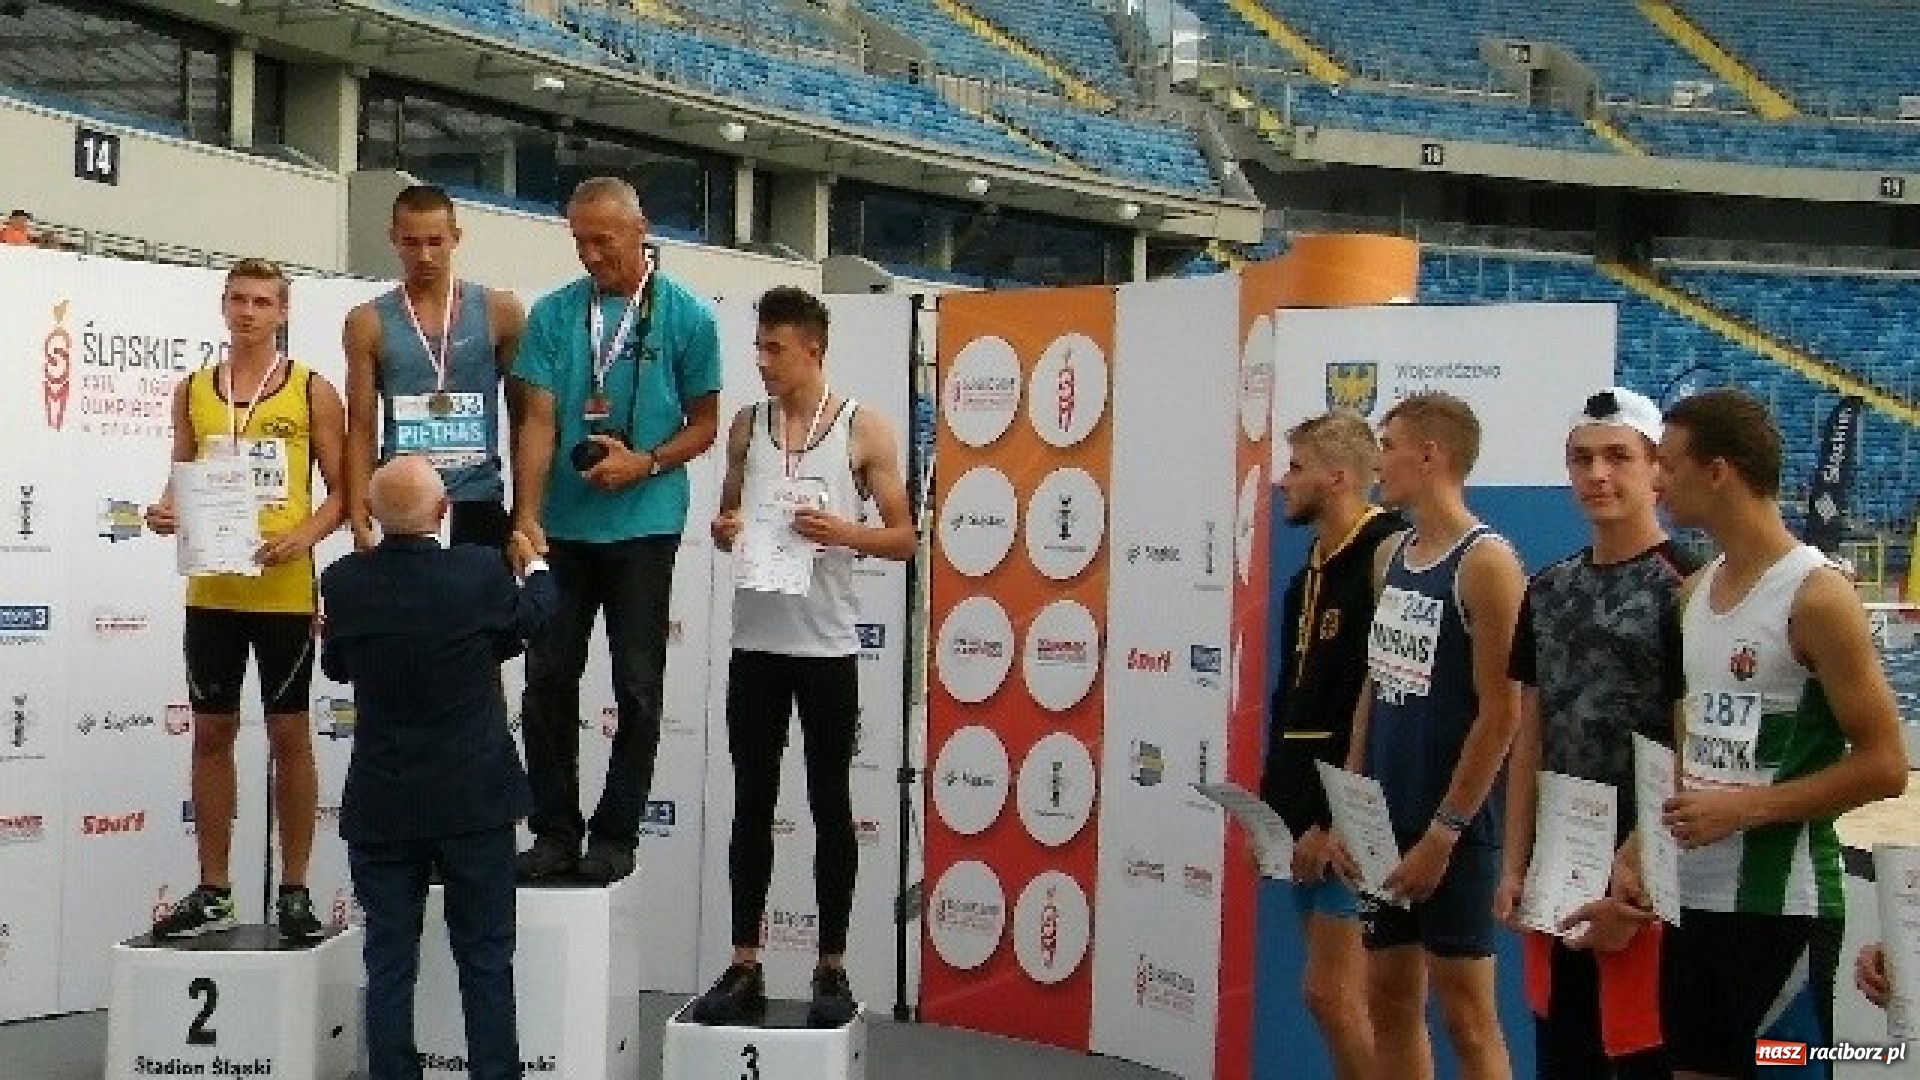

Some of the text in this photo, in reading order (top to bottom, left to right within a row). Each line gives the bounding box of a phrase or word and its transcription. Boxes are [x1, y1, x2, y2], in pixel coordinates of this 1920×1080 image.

[83, 138, 112, 174] 14
[82, 320, 188, 373] ŚLĄSKIE
[186, 976, 218, 1045] 2
[134, 1055, 204, 1075] Stadion
